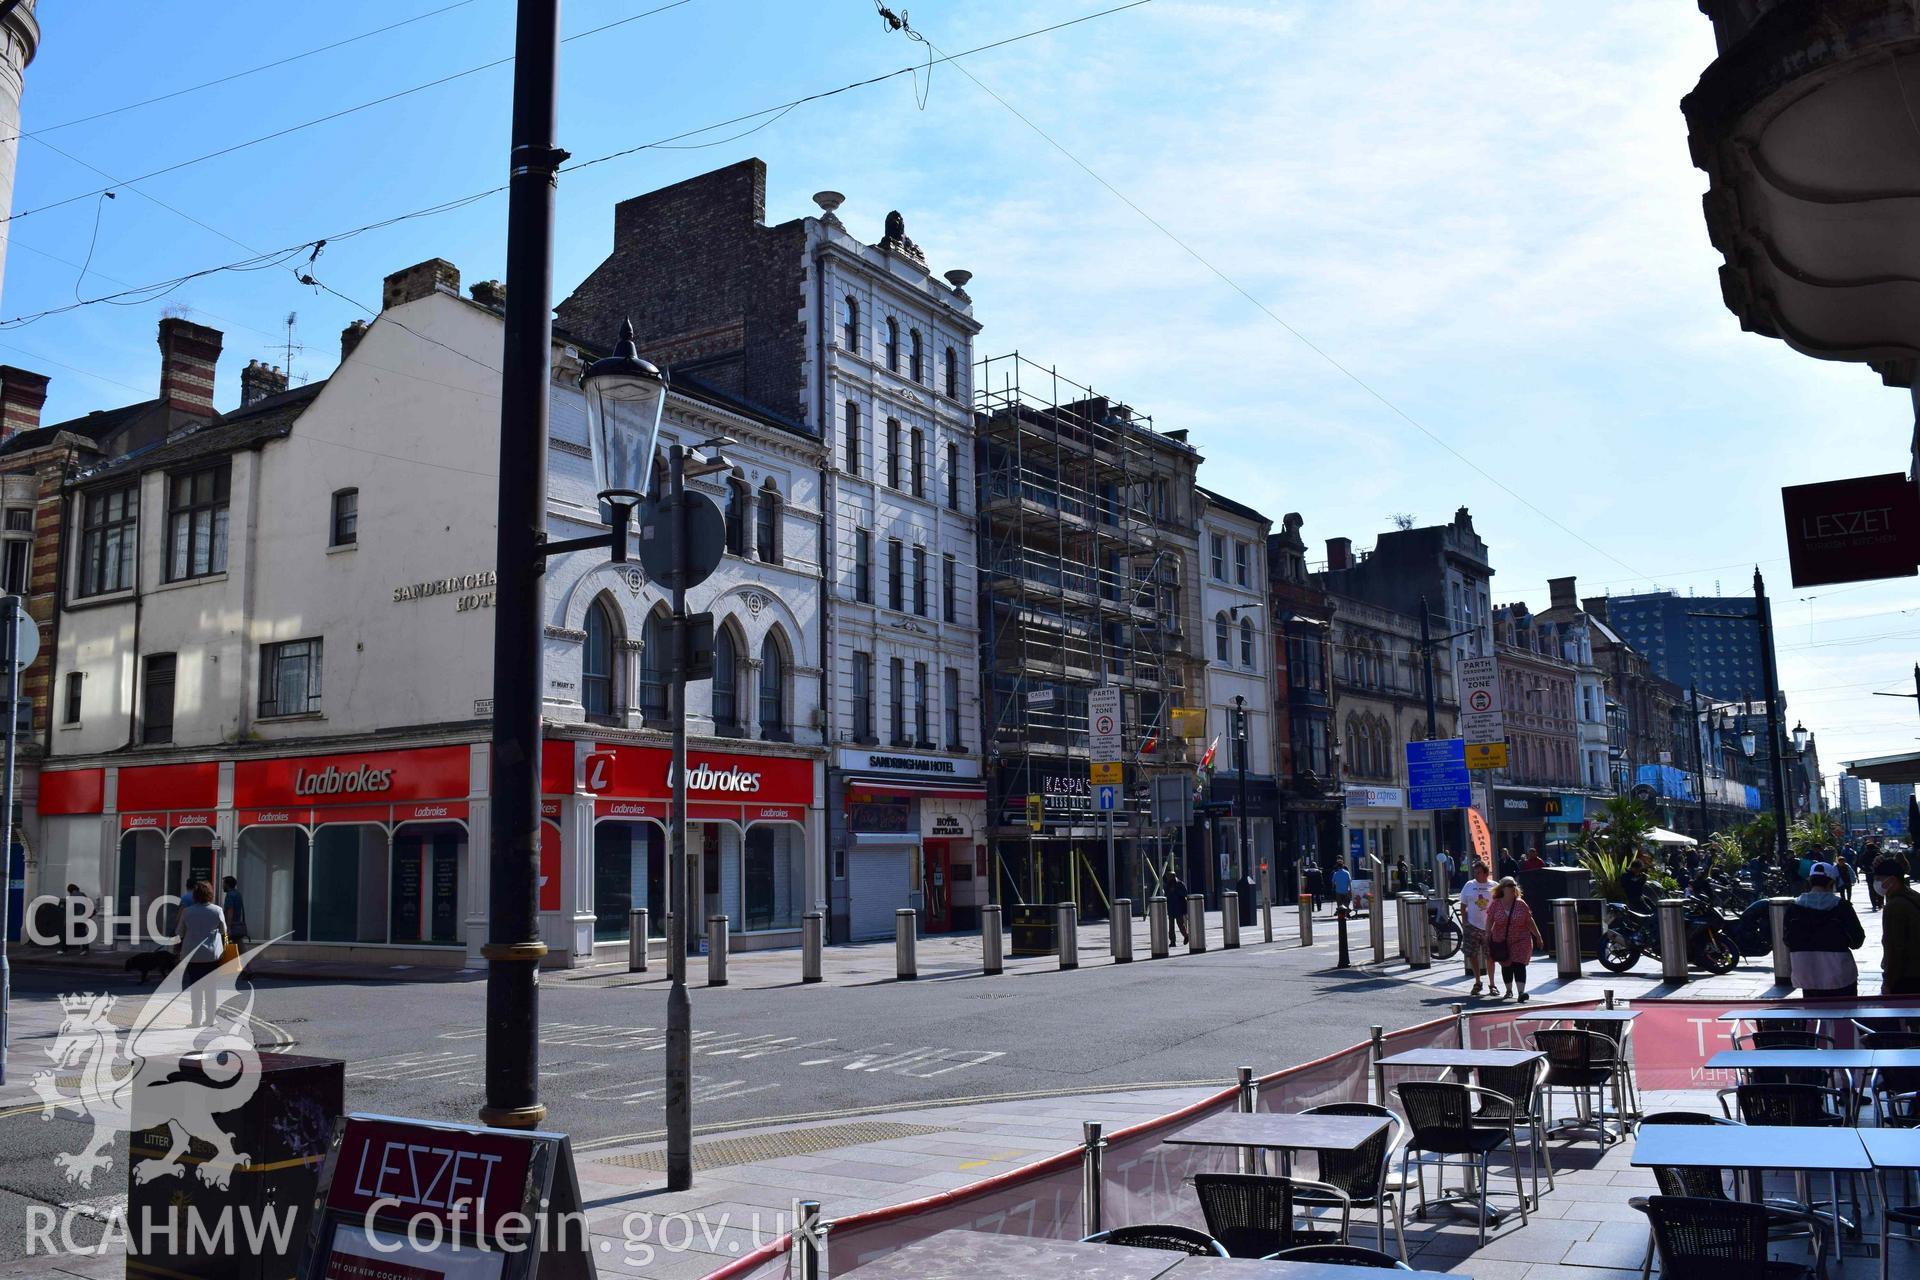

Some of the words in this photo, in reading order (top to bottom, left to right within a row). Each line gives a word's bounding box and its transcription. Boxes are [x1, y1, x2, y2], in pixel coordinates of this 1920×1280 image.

[392, 570, 497, 602] SANDRINGHA
[1463, 660, 1491, 669] PARTH
[1467, 680, 1491, 688] ZONE
[869, 756, 930, 771] SANDRINGHAM
[930, 760, 956, 773] HOTEL
[295, 764, 392, 795] Ladbrokes
[414, 807, 448, 817] Ladbrokes
[610, 803, 646, 814] Ladbrokes
[760, 808, 789, 818] Ladbrokes
[130, 816, 157, 826] Ladbrokes
[179, 815, 208, 824] Ladbrokes
[258, 812, 288, 822] Ladbrokes
[936, 817, 960, 826] HOTEL
[144, 1133, 169, 1147] LITTER
[343, 1264, 357, 1273] OUR
[359, 1267, 375, 1277] NEW
